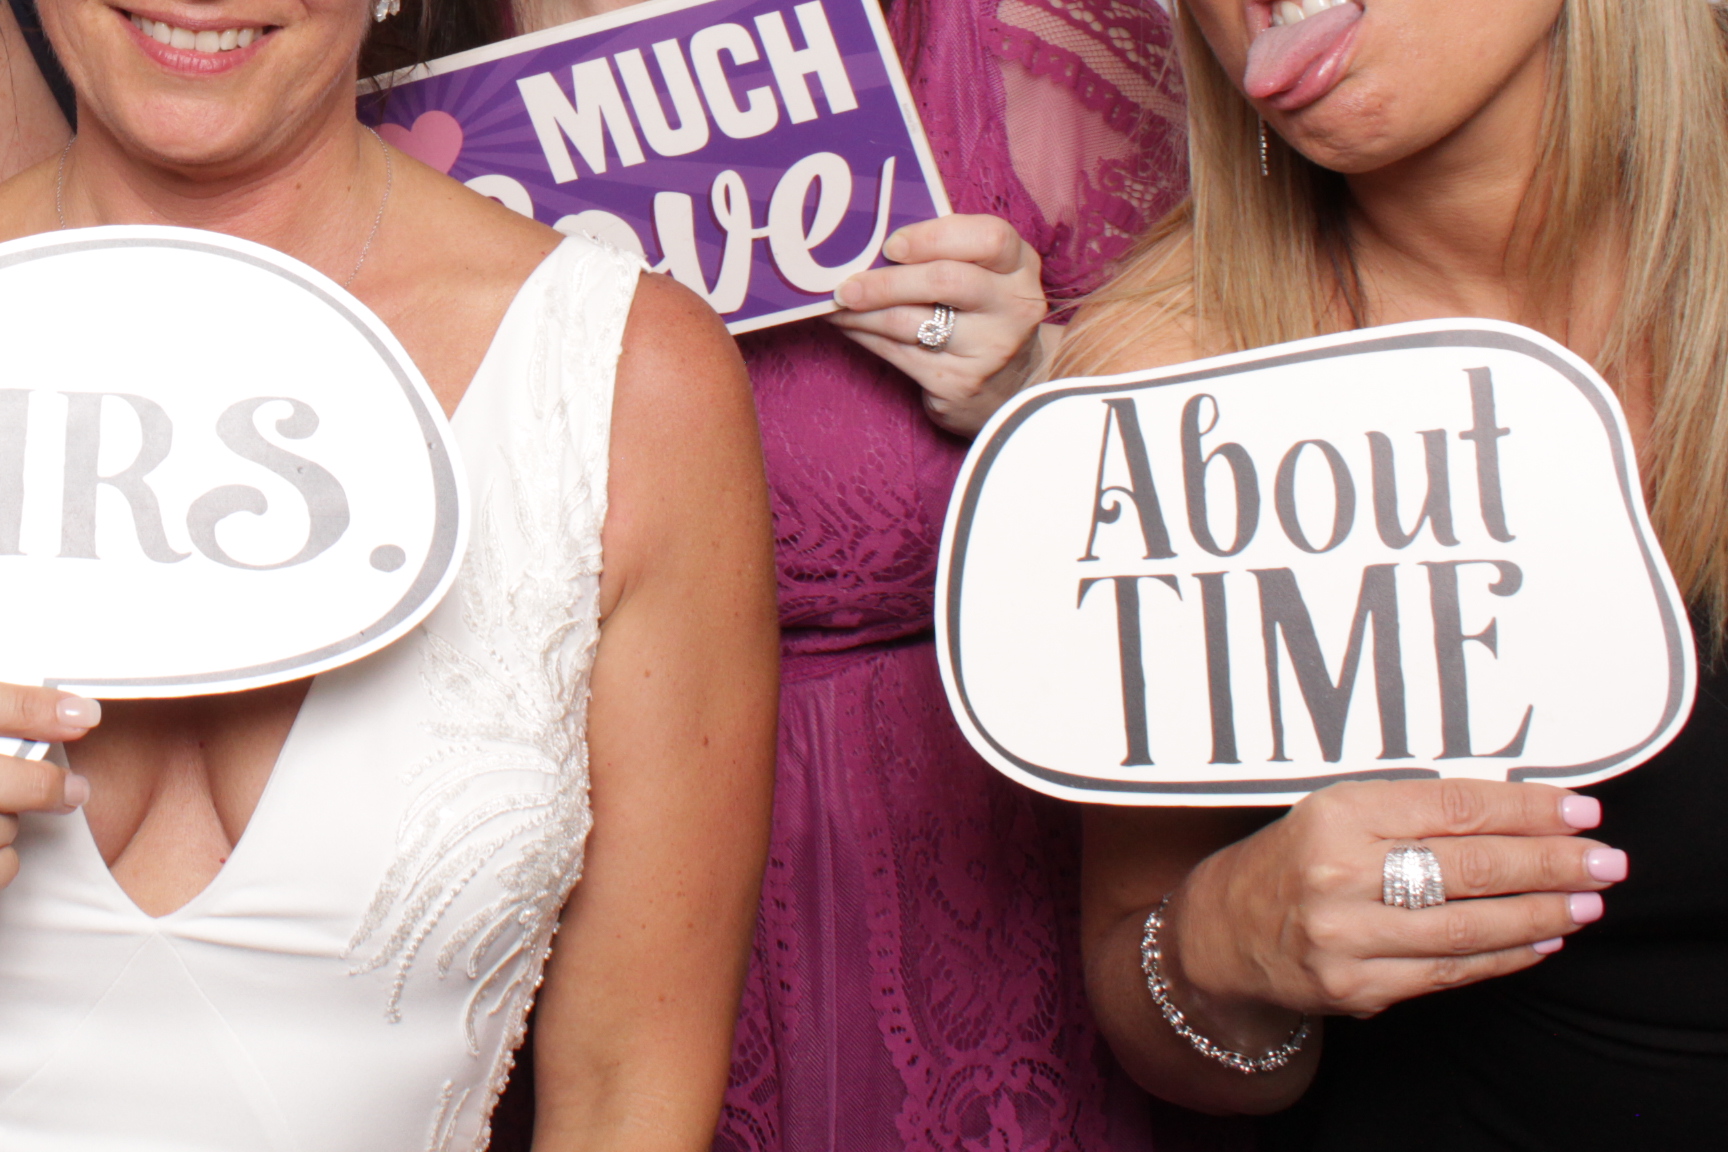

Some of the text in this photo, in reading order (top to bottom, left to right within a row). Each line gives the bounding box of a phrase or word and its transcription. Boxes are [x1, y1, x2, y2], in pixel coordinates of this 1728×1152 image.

[516, 0, 858, 184] MUCH
[463, 151, 895, 314] ve
[1076, 366, 1516, 562] About
[1076, 559, 1534, 766] TIME
